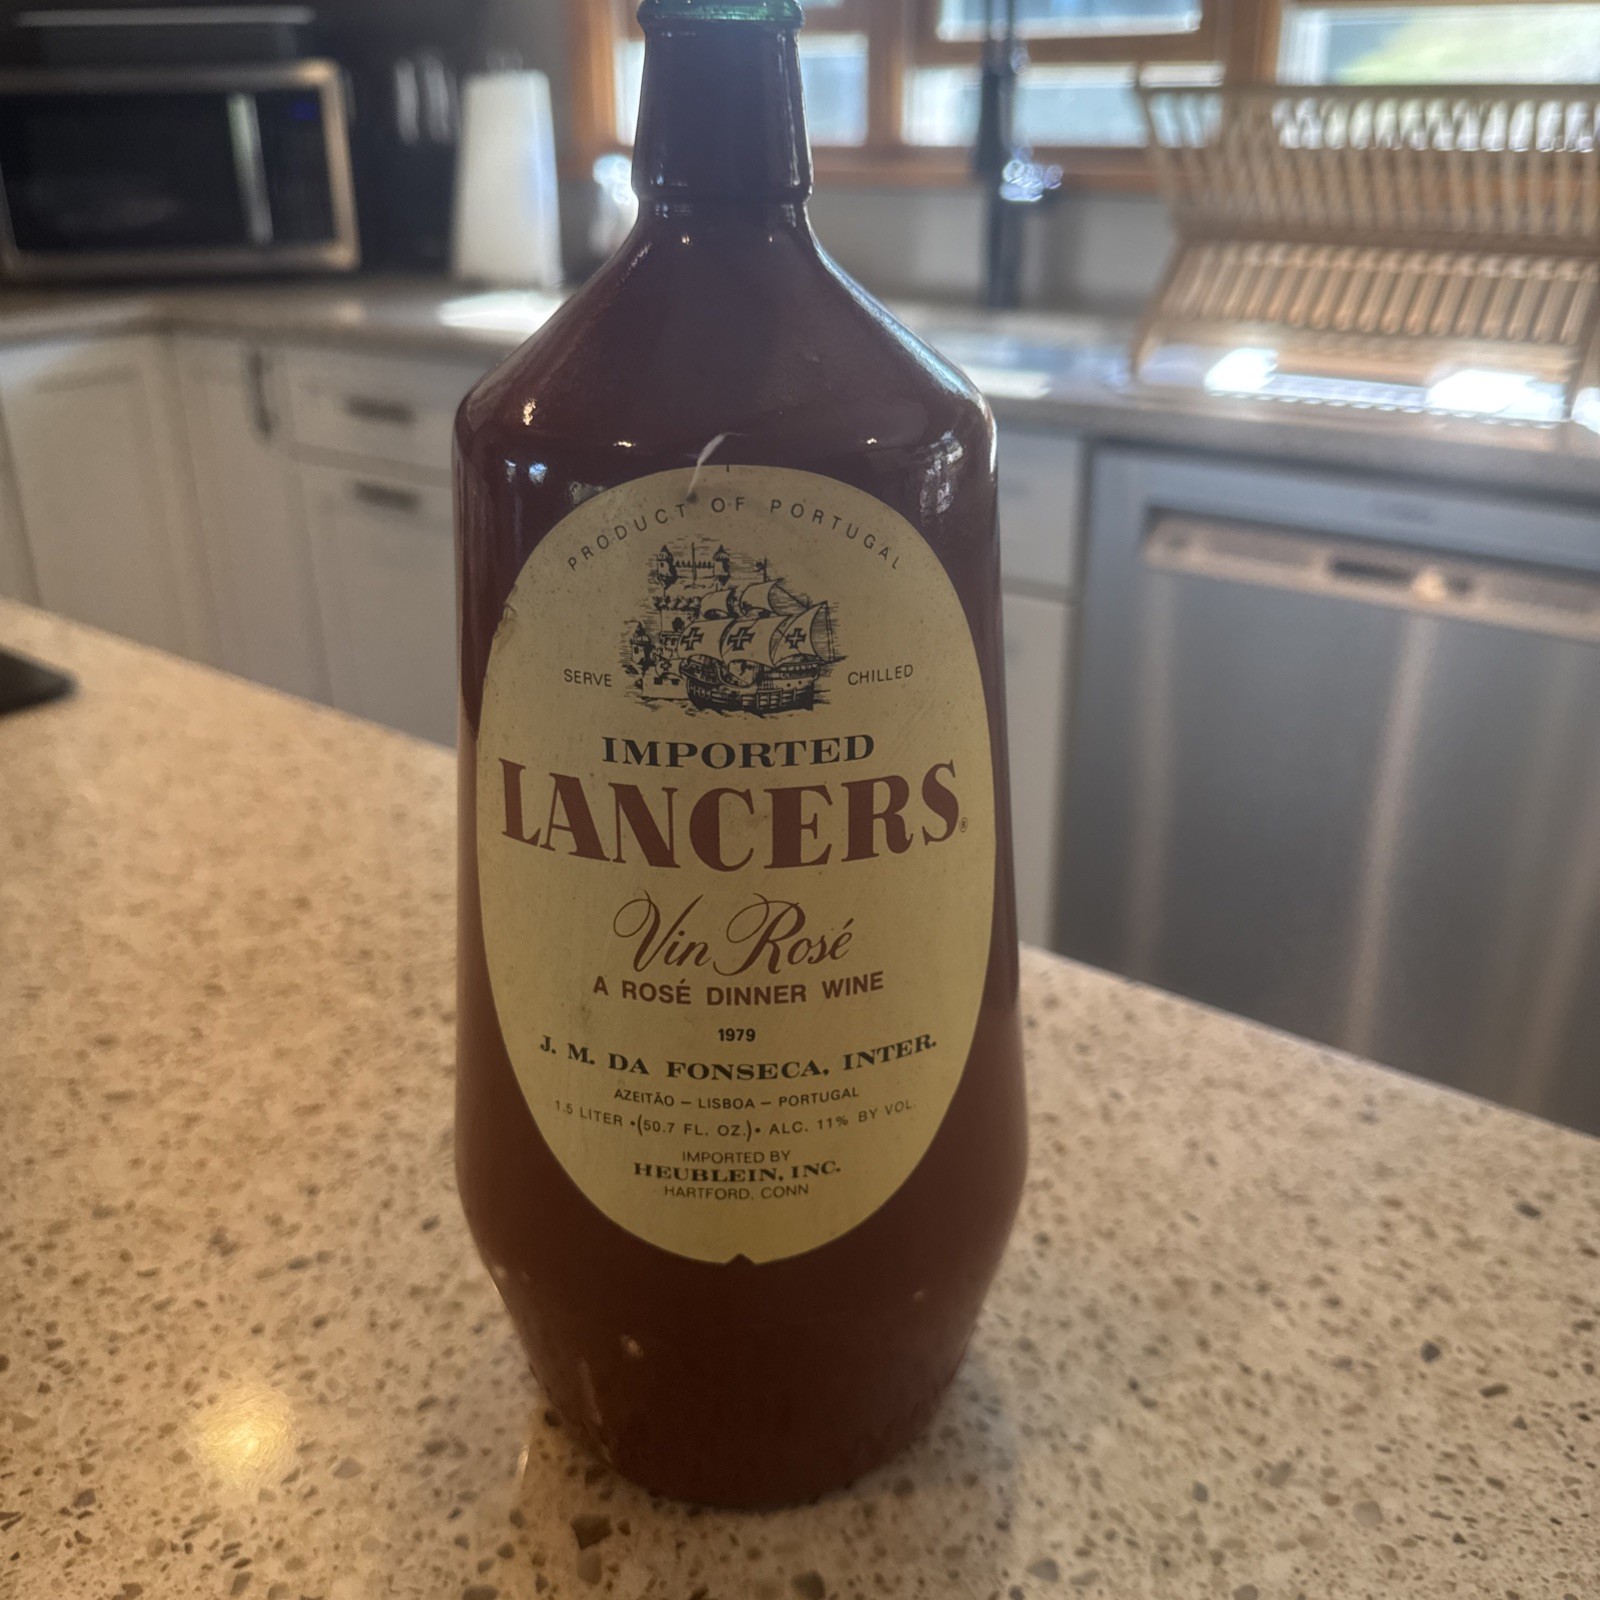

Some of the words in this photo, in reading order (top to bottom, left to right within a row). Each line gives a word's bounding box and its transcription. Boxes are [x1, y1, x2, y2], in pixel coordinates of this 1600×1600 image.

[567, 503, 687, 571] PRODUCT
[711, 496, 746, 513] OF
[770, 499, 901, 570] PORTUGAL
[563, 668, 613, 688] SERVE
[847, 663, 914, 687] CHILLED
[602, 734, 875, 769] IMPORTED
[613, 889, 711, 972] Vin
[713, 892, 854, 977] Rosé
[593, 975, 609, 996] A
[622, 978, 692, 1005] ROSÉ
[706, 984, 807, 1006] DINNER
[821, 970, 884, 999] WINE
[718, 1028, 756, 1042] 1979
[540, 1035, 557, 1054] J.
[567, 1043, 596, 1065] M.
[608, 1053, 650, 1075] DA
[666, 1059, 829, 1081] FONSECA,
[843, 1034, 937, 1070] INTER.
[698, 1097, 755, 1110] LISBOA
[779, 1086, 859, 1107] PORTUGAL
[555, 1100, 573, 1114] 1.5
[580, 1107, 623, 1127] LITER
[684, 1123, 709, 1136] FL.
[769, 1121, 808, 1136] ALC.
[817, 1115, 848, 1130] 11%
[858, 1108, 878, 1123] BY
[884, 1099, 917, 1116] VOL.
[682, 1150, 765, 1164] IMPORTED
[770, 1149, 791, 1162] BY
[634, 1162, 783, 1182] HEUBLEIN,
[791, 1160, 841, 1179] INC.
[761, 1184, 809, 1198] CONN
